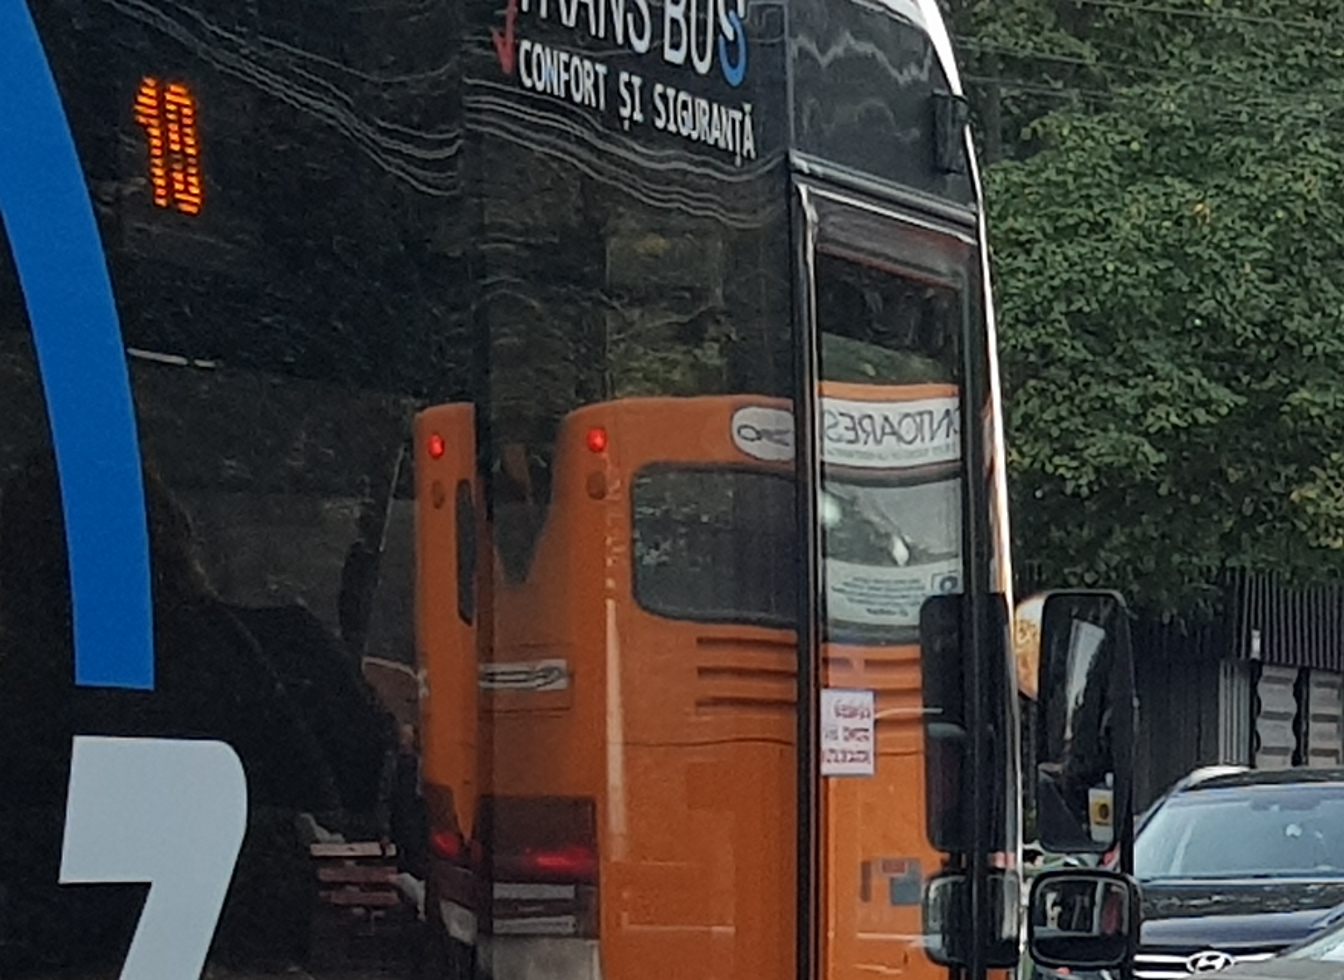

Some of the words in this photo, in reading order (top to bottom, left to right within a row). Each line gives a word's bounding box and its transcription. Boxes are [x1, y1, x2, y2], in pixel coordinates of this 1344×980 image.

[518, 39, 608, 111] CONFORT
[618, 71, 643, 131] ȘI
[133, 75, 202, 215] 10
